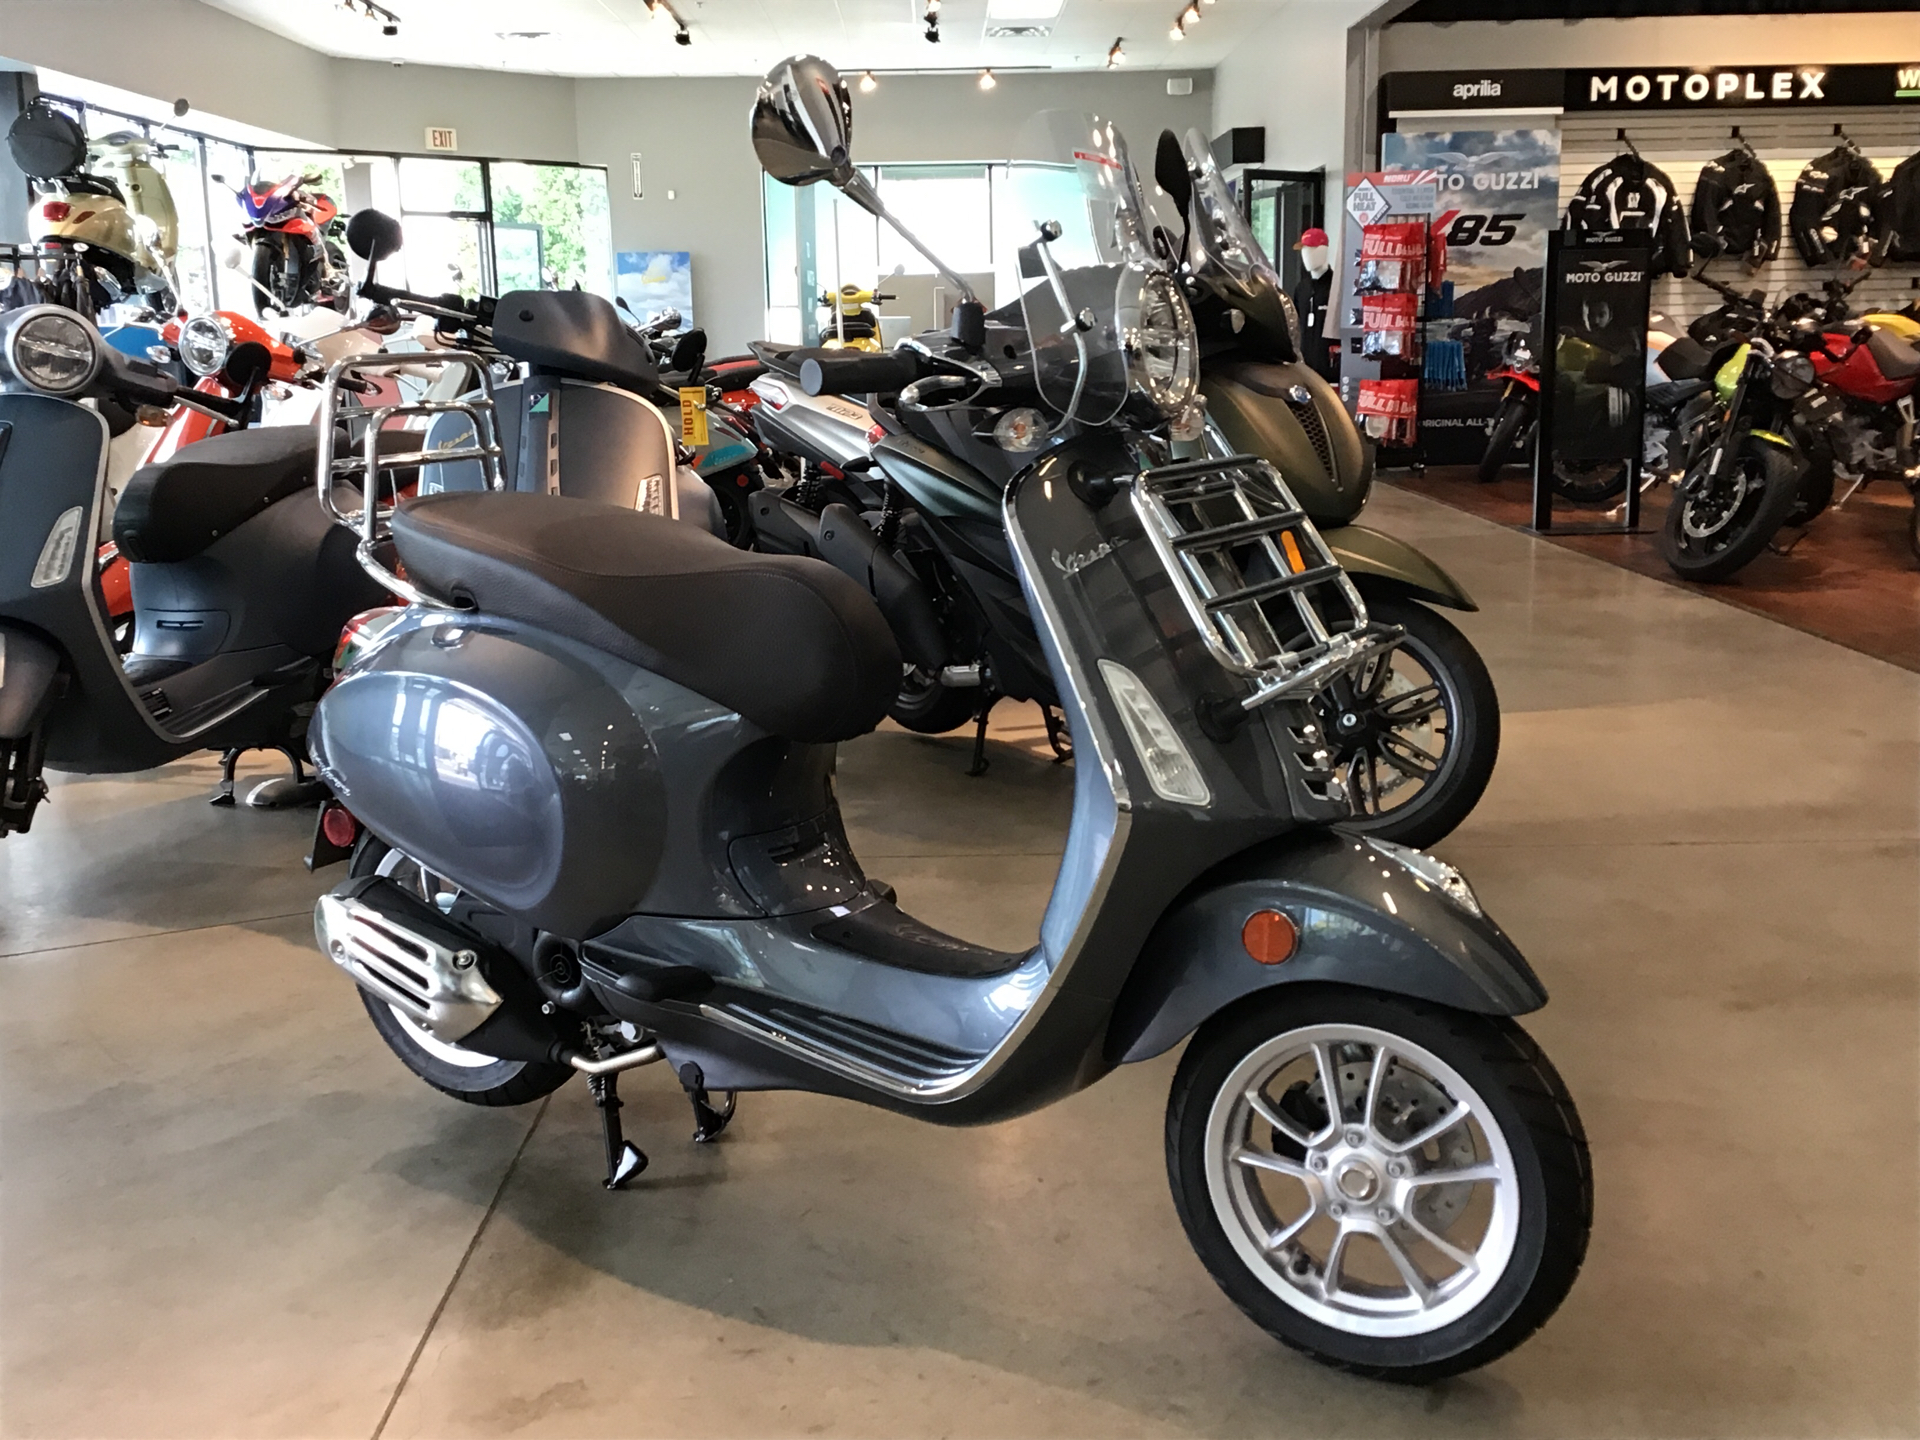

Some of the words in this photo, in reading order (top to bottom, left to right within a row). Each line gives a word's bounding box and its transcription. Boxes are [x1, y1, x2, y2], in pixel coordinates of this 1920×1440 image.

[1453, 79, 1501, 100] aprilia
[1590, 72, 1826, 102] MOTOPLEX
[432, 129, 453, 148] EXIT
[1436, 173, 1465, 191] TO
[1473, 171, 1540, 191] GUZZI
[1353, 192, 1375, 202] FULL
[1353, 201, 1377, 211] HEAT
[1566, 272, 1600, 283] MOTO
[1604, 271, 1641, 282] GUZZI
[682, 399, 694, 436] HOLD
[1051, 536, 1130, 580] Vespa
